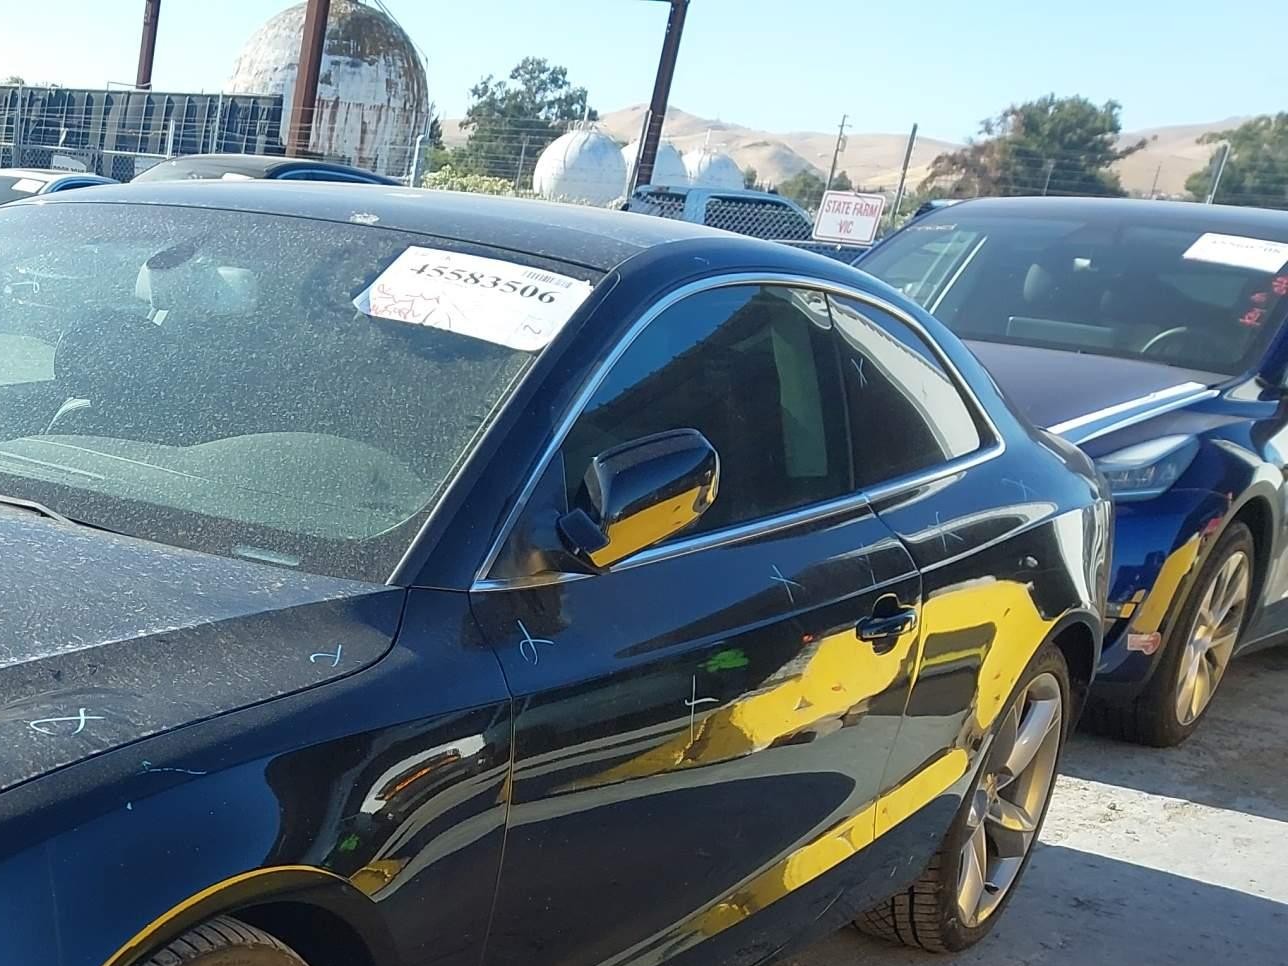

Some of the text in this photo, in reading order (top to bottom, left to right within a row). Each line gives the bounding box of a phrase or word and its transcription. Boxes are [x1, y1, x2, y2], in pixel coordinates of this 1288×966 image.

[825, 200, 880, 218] STATE FARM
[410, 263, 561, 304] 45583506
